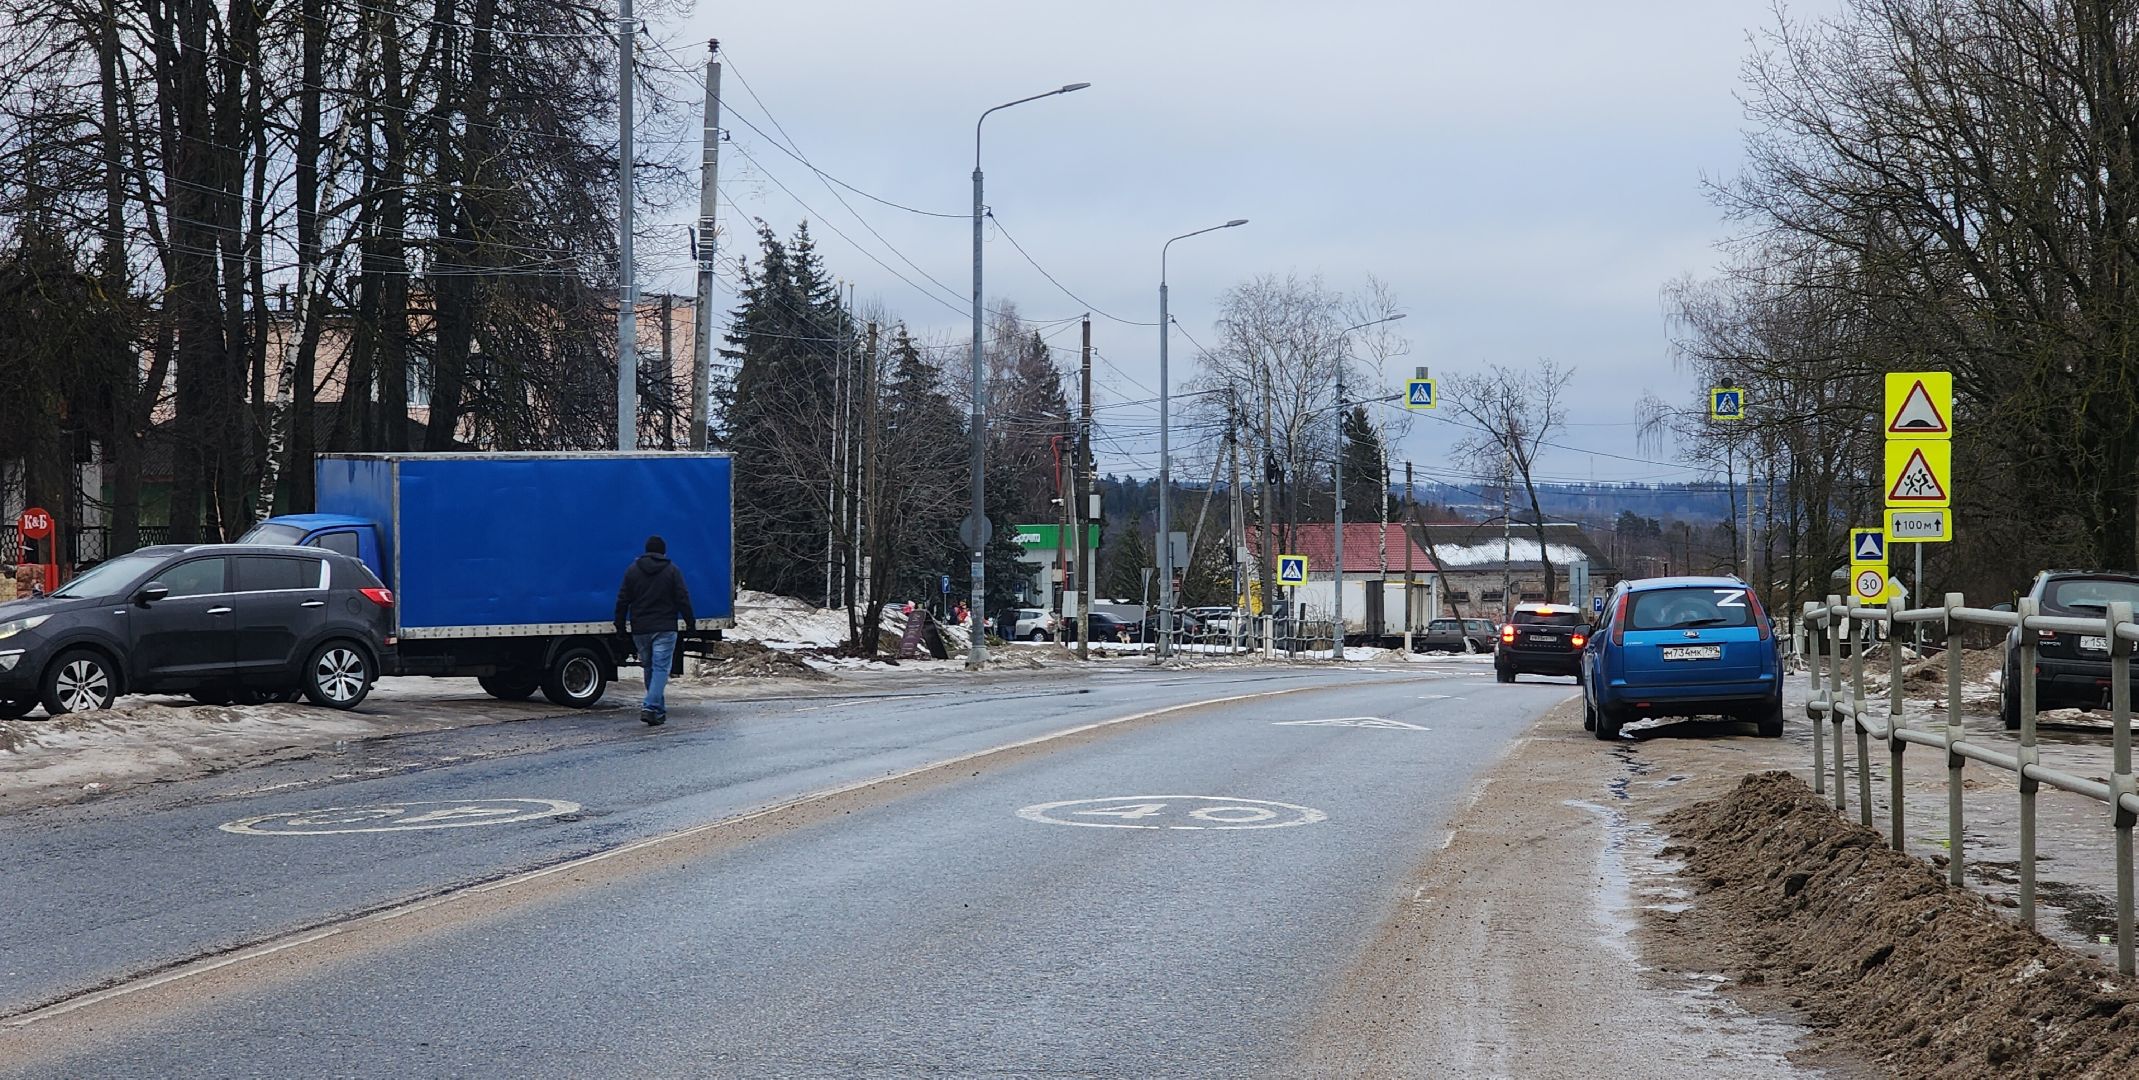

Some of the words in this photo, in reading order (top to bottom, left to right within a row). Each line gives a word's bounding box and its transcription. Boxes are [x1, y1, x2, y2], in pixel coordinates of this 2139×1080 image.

[24, 515, 47, 529] К&Б
[1903, 520, 1932, 530] 100м
[1862, 579, 1877, 590] 30
[1595, 598, 1601, 610] P
[1713, 590, 1746, 607] Z
[1072, 803, 1277, 822] 40
